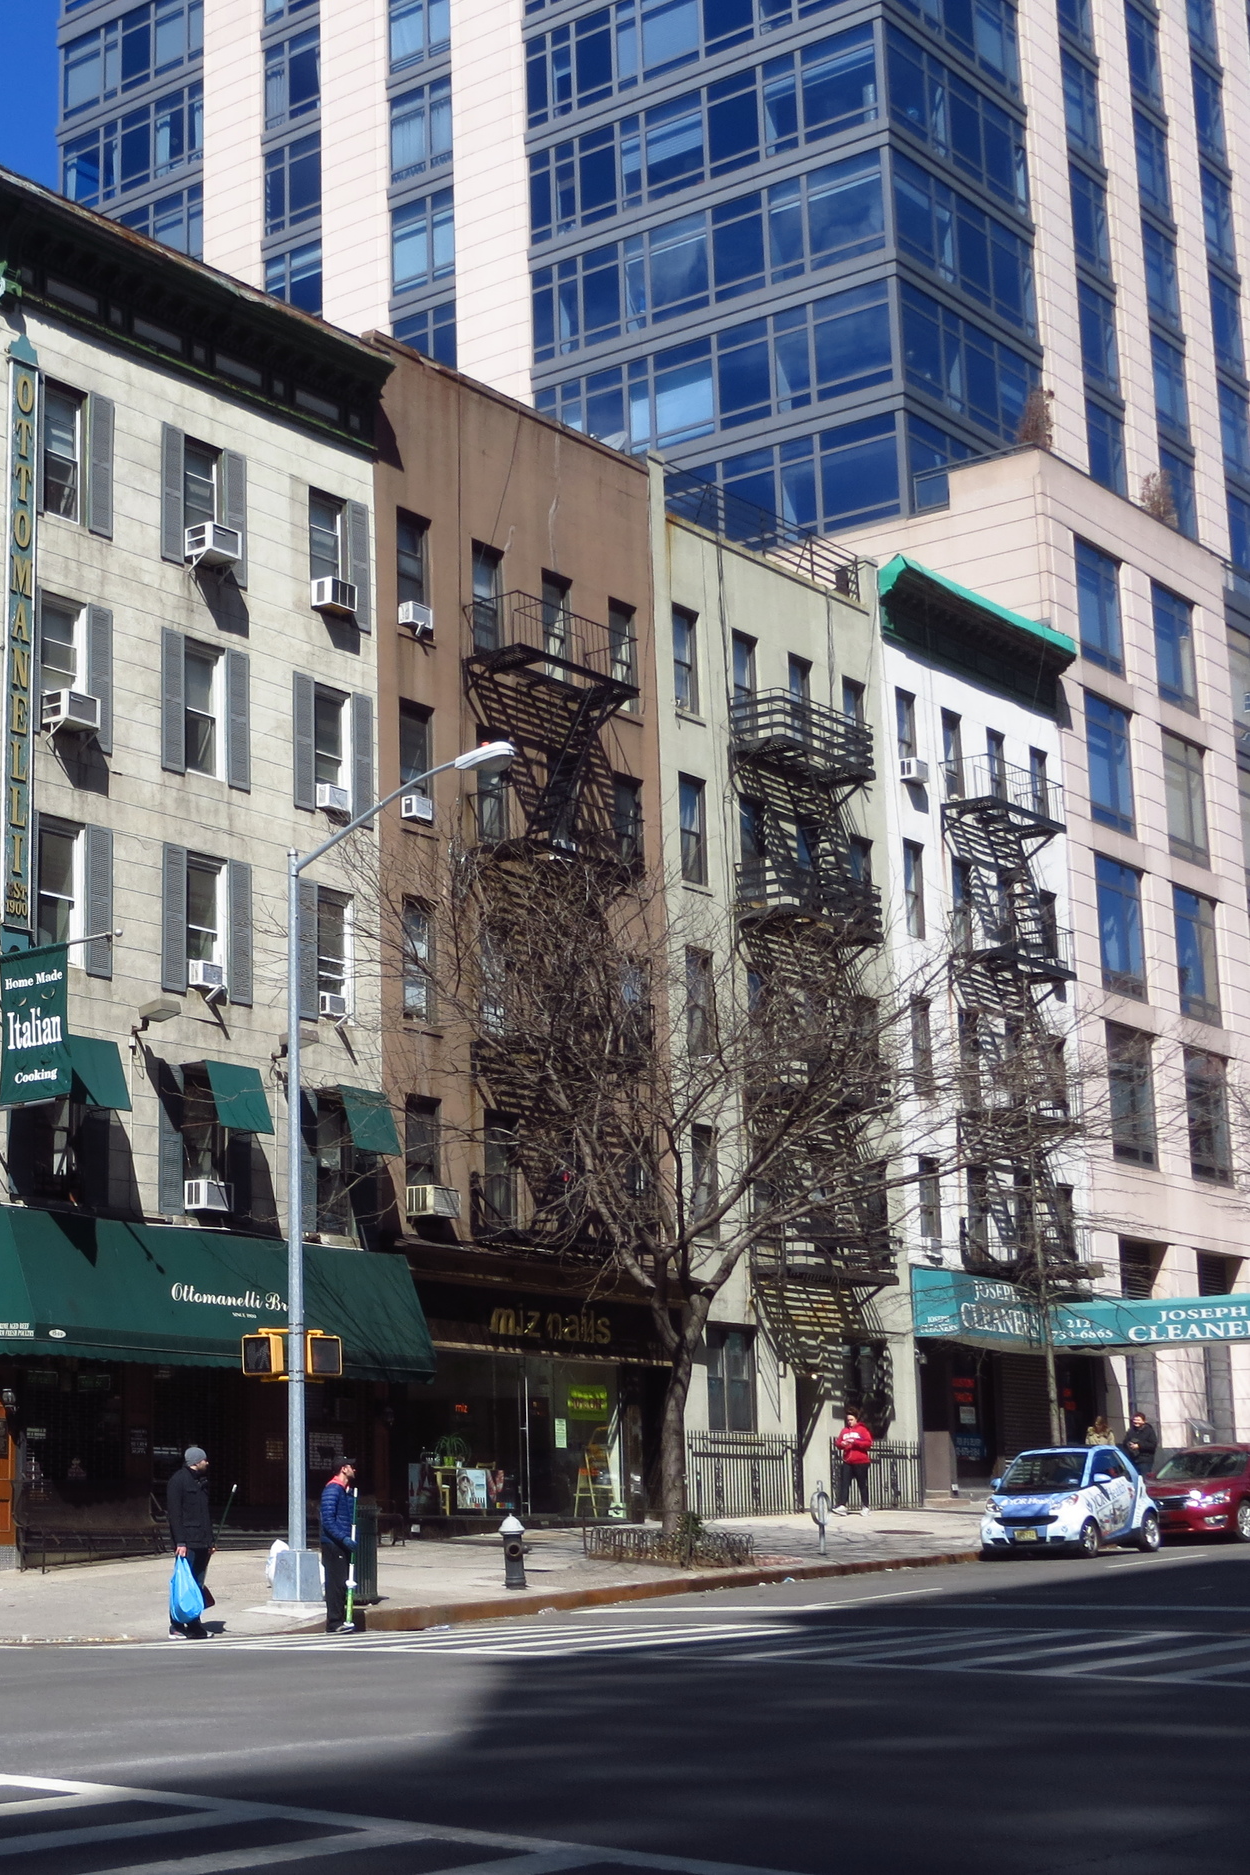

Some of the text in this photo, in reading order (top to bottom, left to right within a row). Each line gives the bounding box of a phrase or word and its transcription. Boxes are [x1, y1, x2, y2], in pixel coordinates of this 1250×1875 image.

[10, 375, 35, 875] OTTOMANELLI
[6, 899, 28, 916] 1900
[4, 968, 63, 990] Home Made
[7, 1006, 62, 1050] Italian
[14, 1068, 58, 1084] Cooking
[171, 1282, 263, 1309] Ottomanelli
[1067, 1319, 1091, 1328] 212
[1157, 1306, 1248, 1324] JOSEPH
[546, 1309, 612, 1344] nails
[1128, 1320, 1250, 1341] CLEANE
